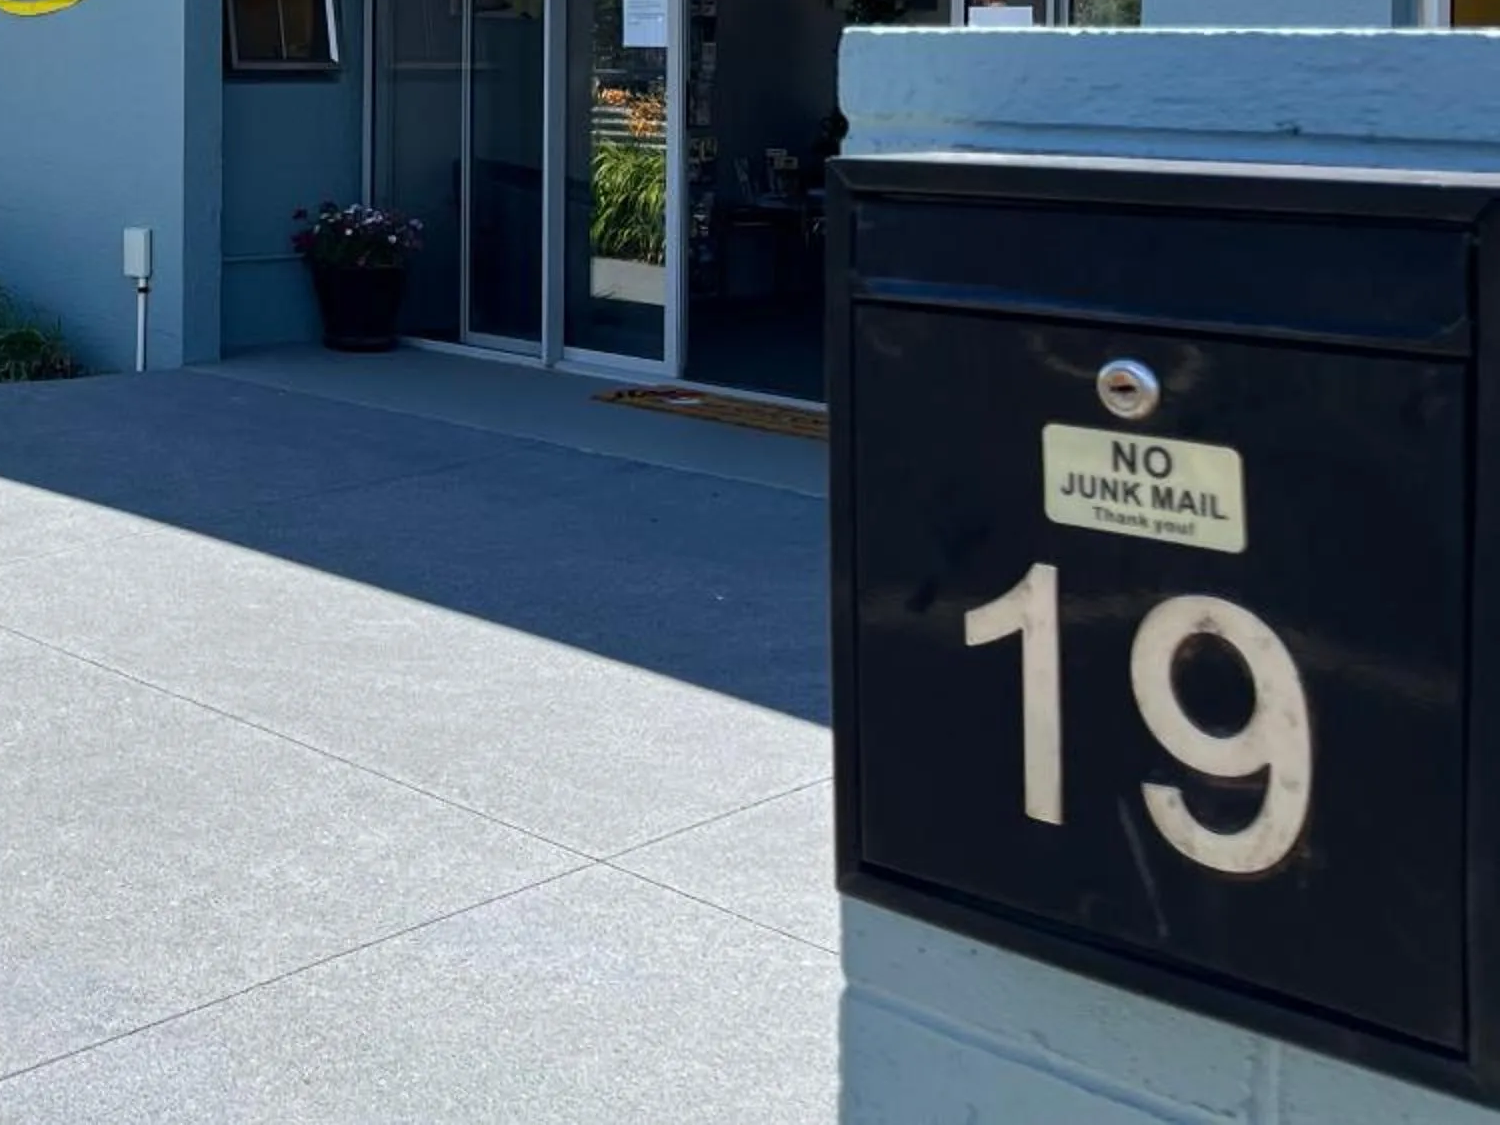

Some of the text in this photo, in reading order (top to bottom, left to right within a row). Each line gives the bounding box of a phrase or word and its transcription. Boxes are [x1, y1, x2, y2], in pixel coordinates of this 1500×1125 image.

[1111, 440, 1173, 479] NO
[1060, 472, 1229, 521] JUNK MAIL
[1092, 506, 1196, 536] Thank you!
[964, 563, 1313, 873] 19
